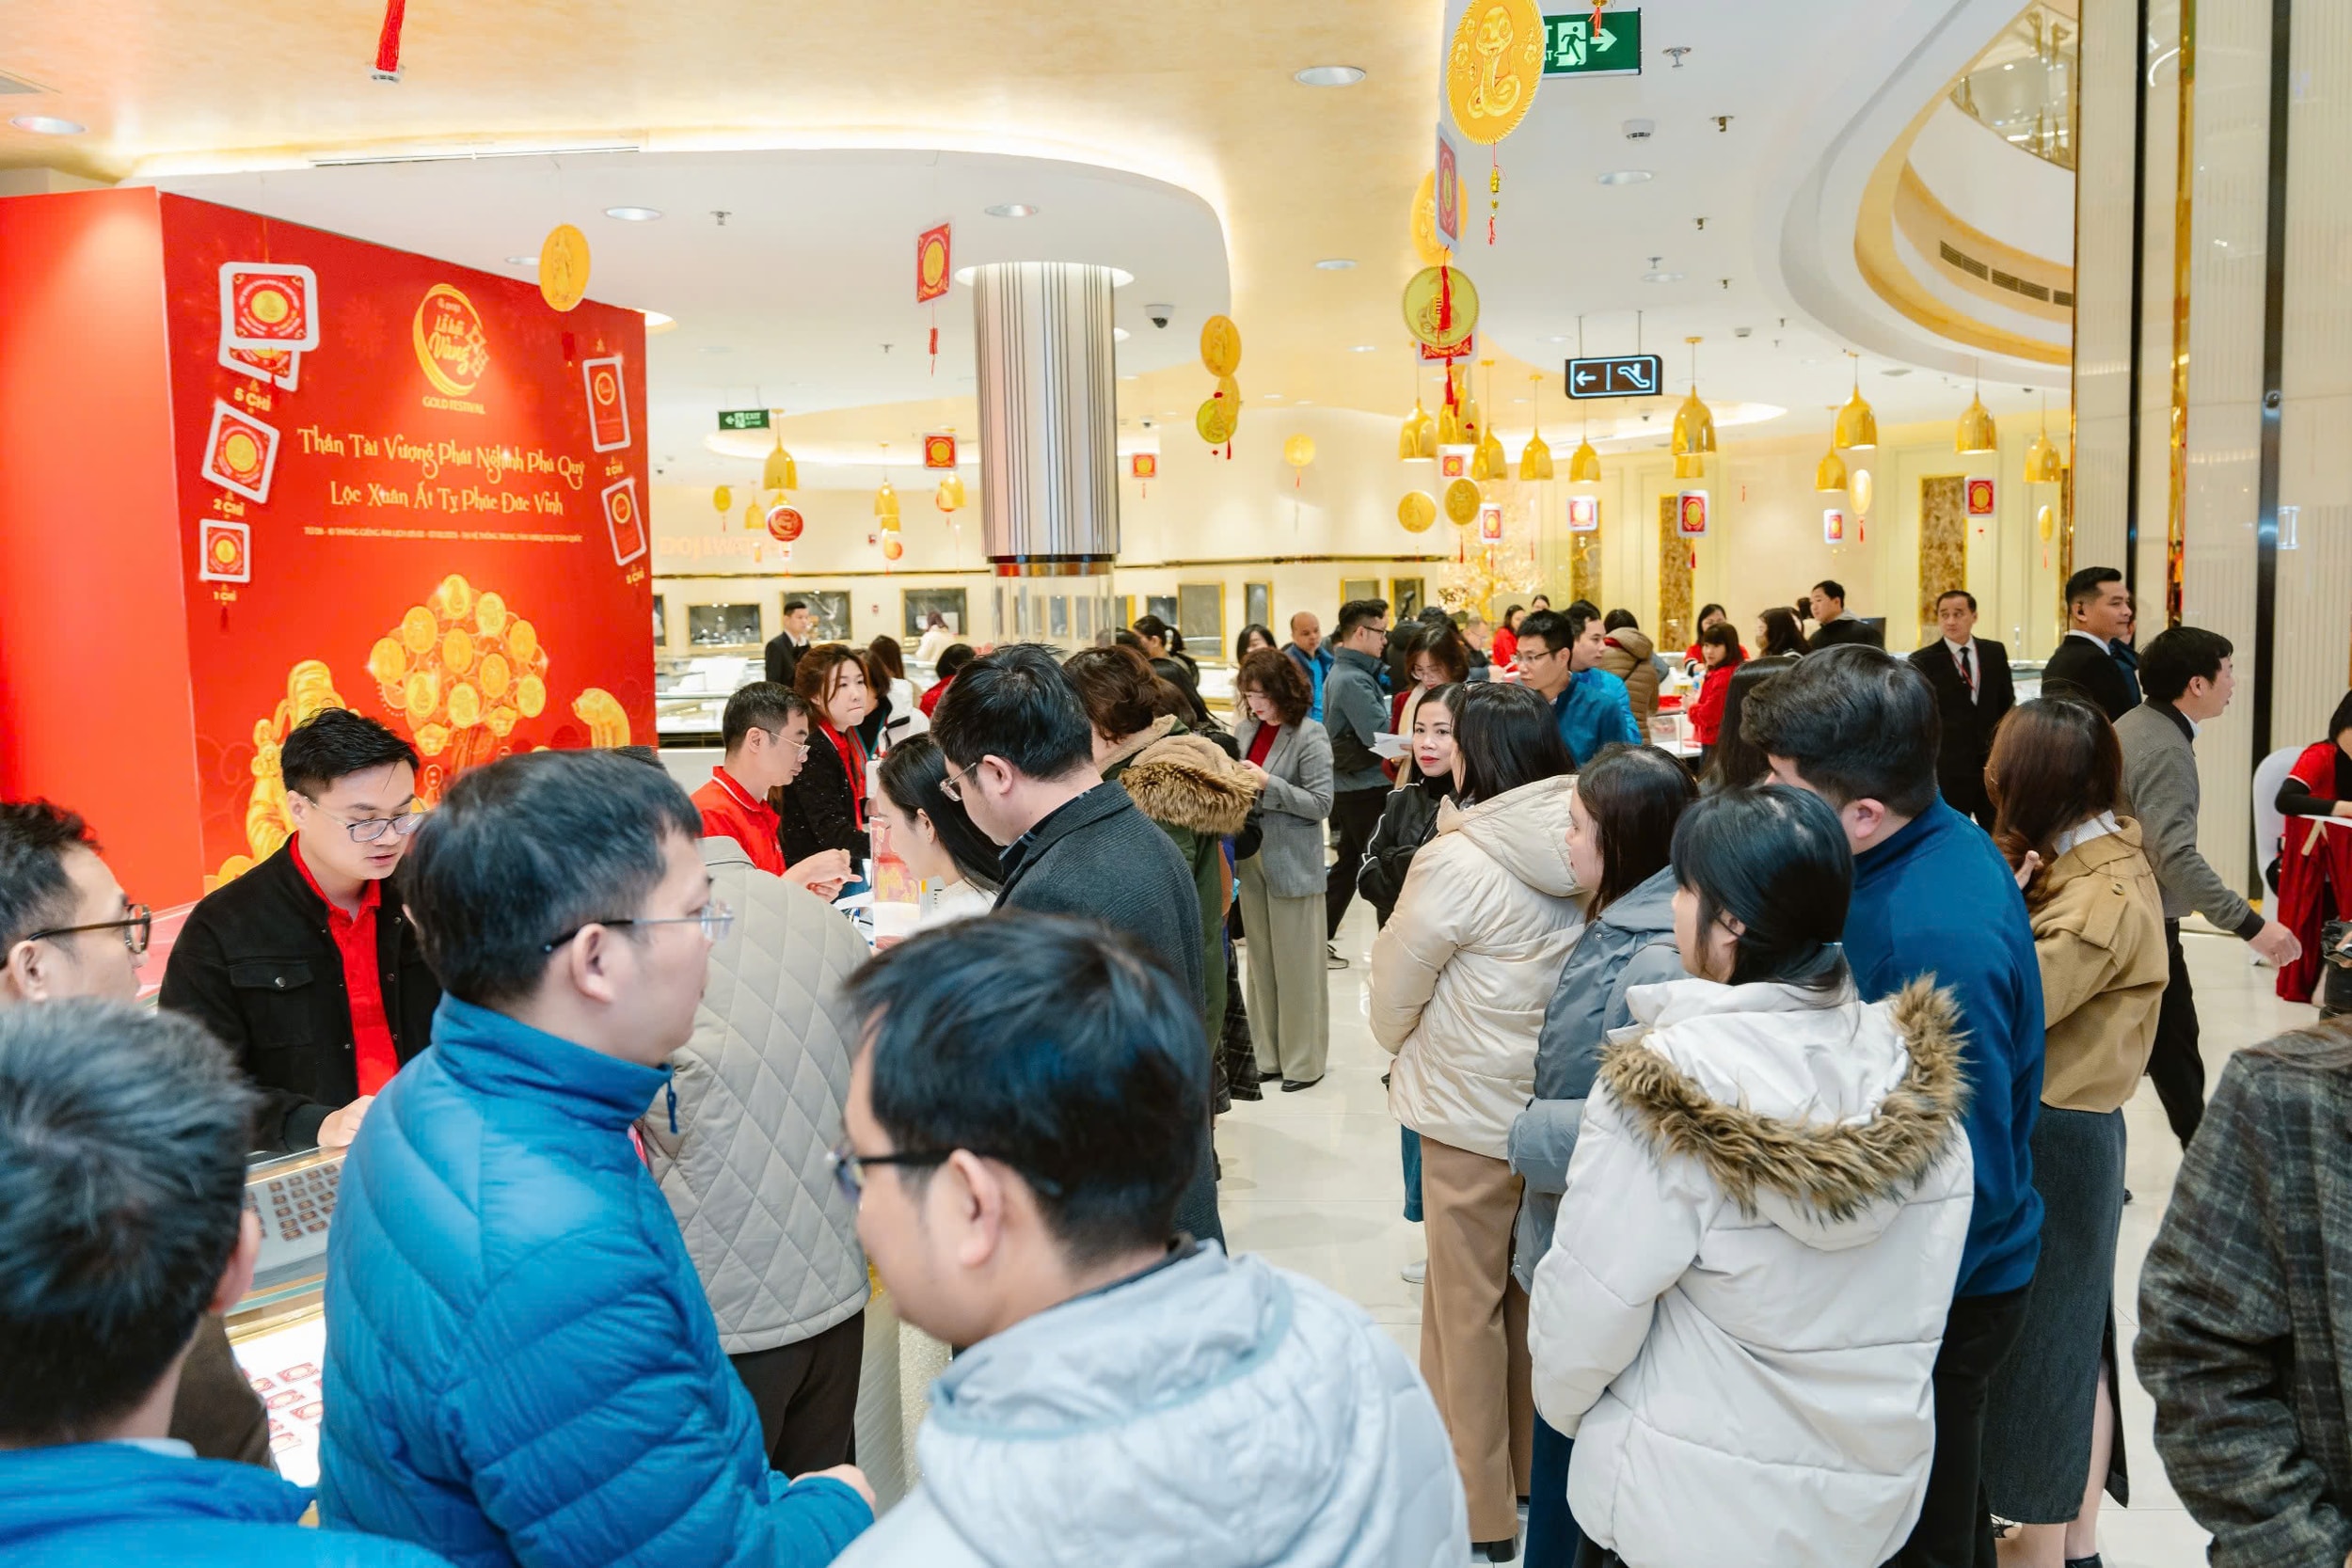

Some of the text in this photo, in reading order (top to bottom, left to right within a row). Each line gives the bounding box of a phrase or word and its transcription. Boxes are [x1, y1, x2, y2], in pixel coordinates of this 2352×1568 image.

[421, 395, 485, 415] GOLD FESTIVAL
[213, 498, 223, 511] 2
